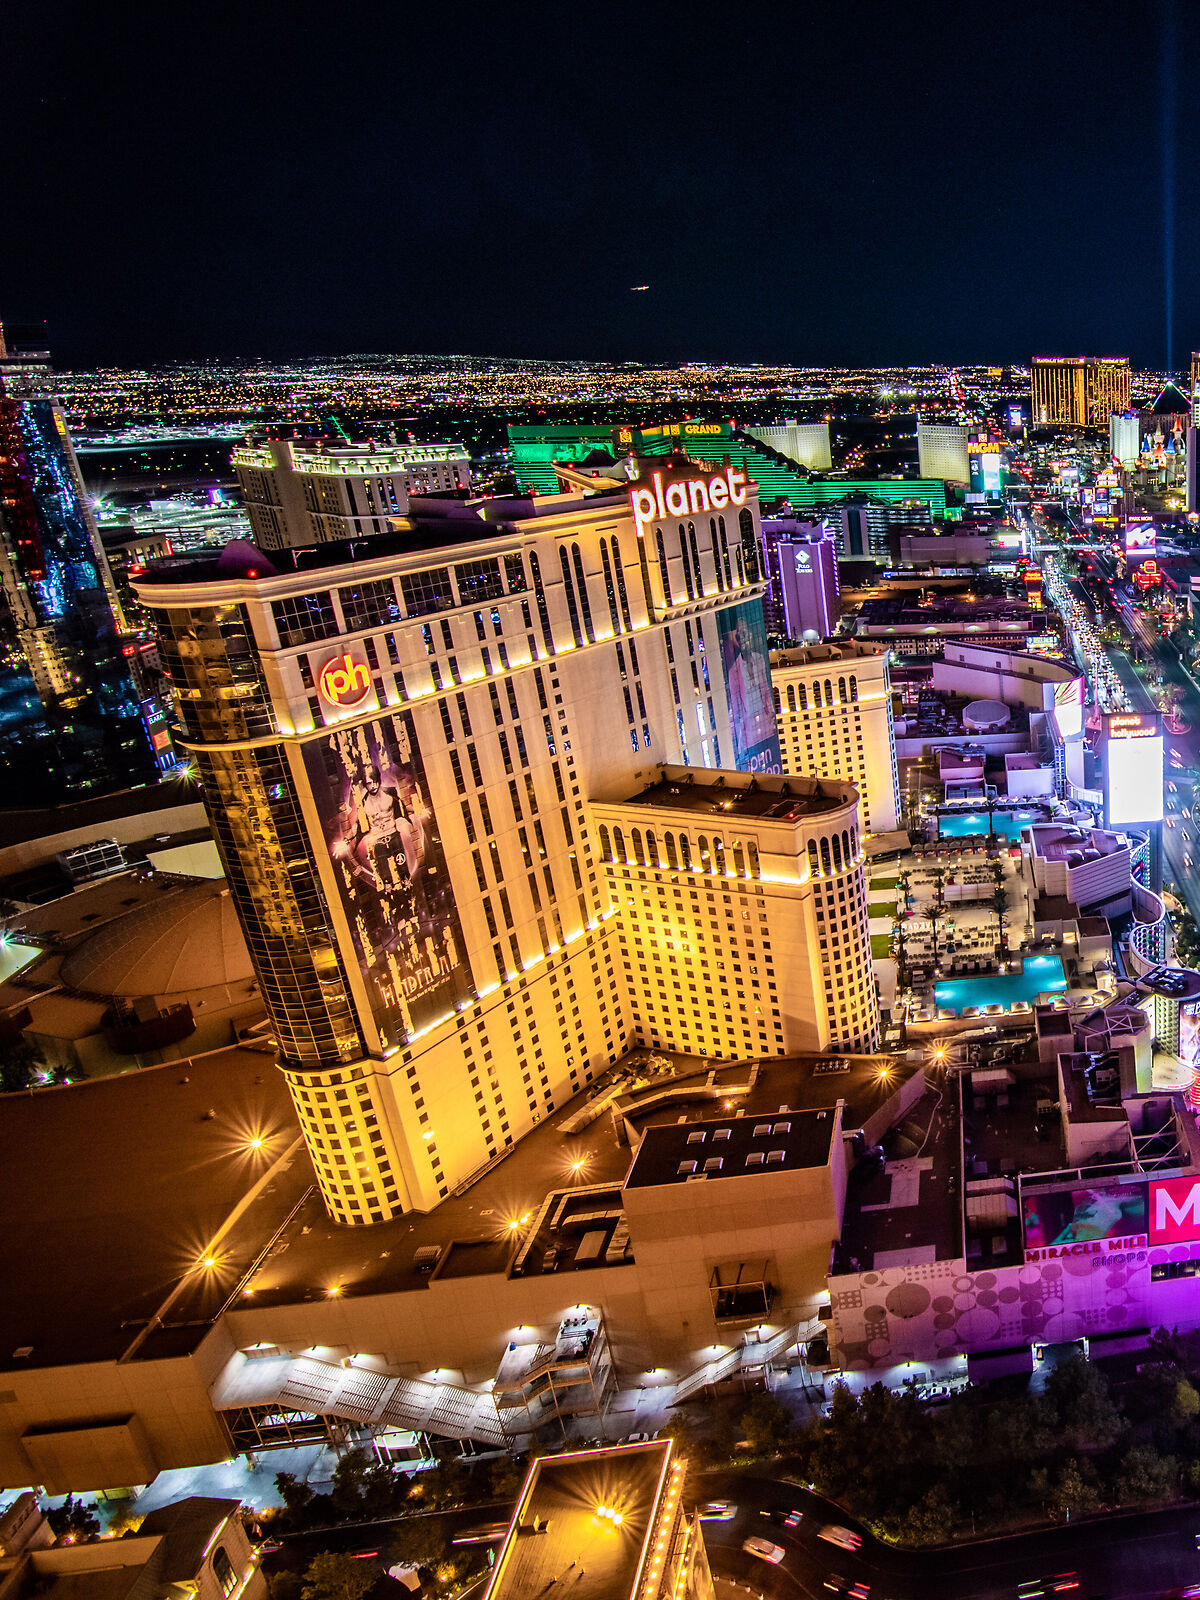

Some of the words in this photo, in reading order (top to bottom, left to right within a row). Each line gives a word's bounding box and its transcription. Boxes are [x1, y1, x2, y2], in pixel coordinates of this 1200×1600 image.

[684, 424, 722, 435] GRAND
[967, 442, 1000, 454] MGM
[630, 467, 747, 538] planet
[325, 654, 370, 702] ph
[1110, 716, 1141, 729] planet
[1110, 726, 1156, 740] hollywood
[1025, 1242, 1102, 1263] MIRACLE
[1107, 1235, 1146, 1252] MILE
[1091, 1250, 1147, 1268] SHOPS
